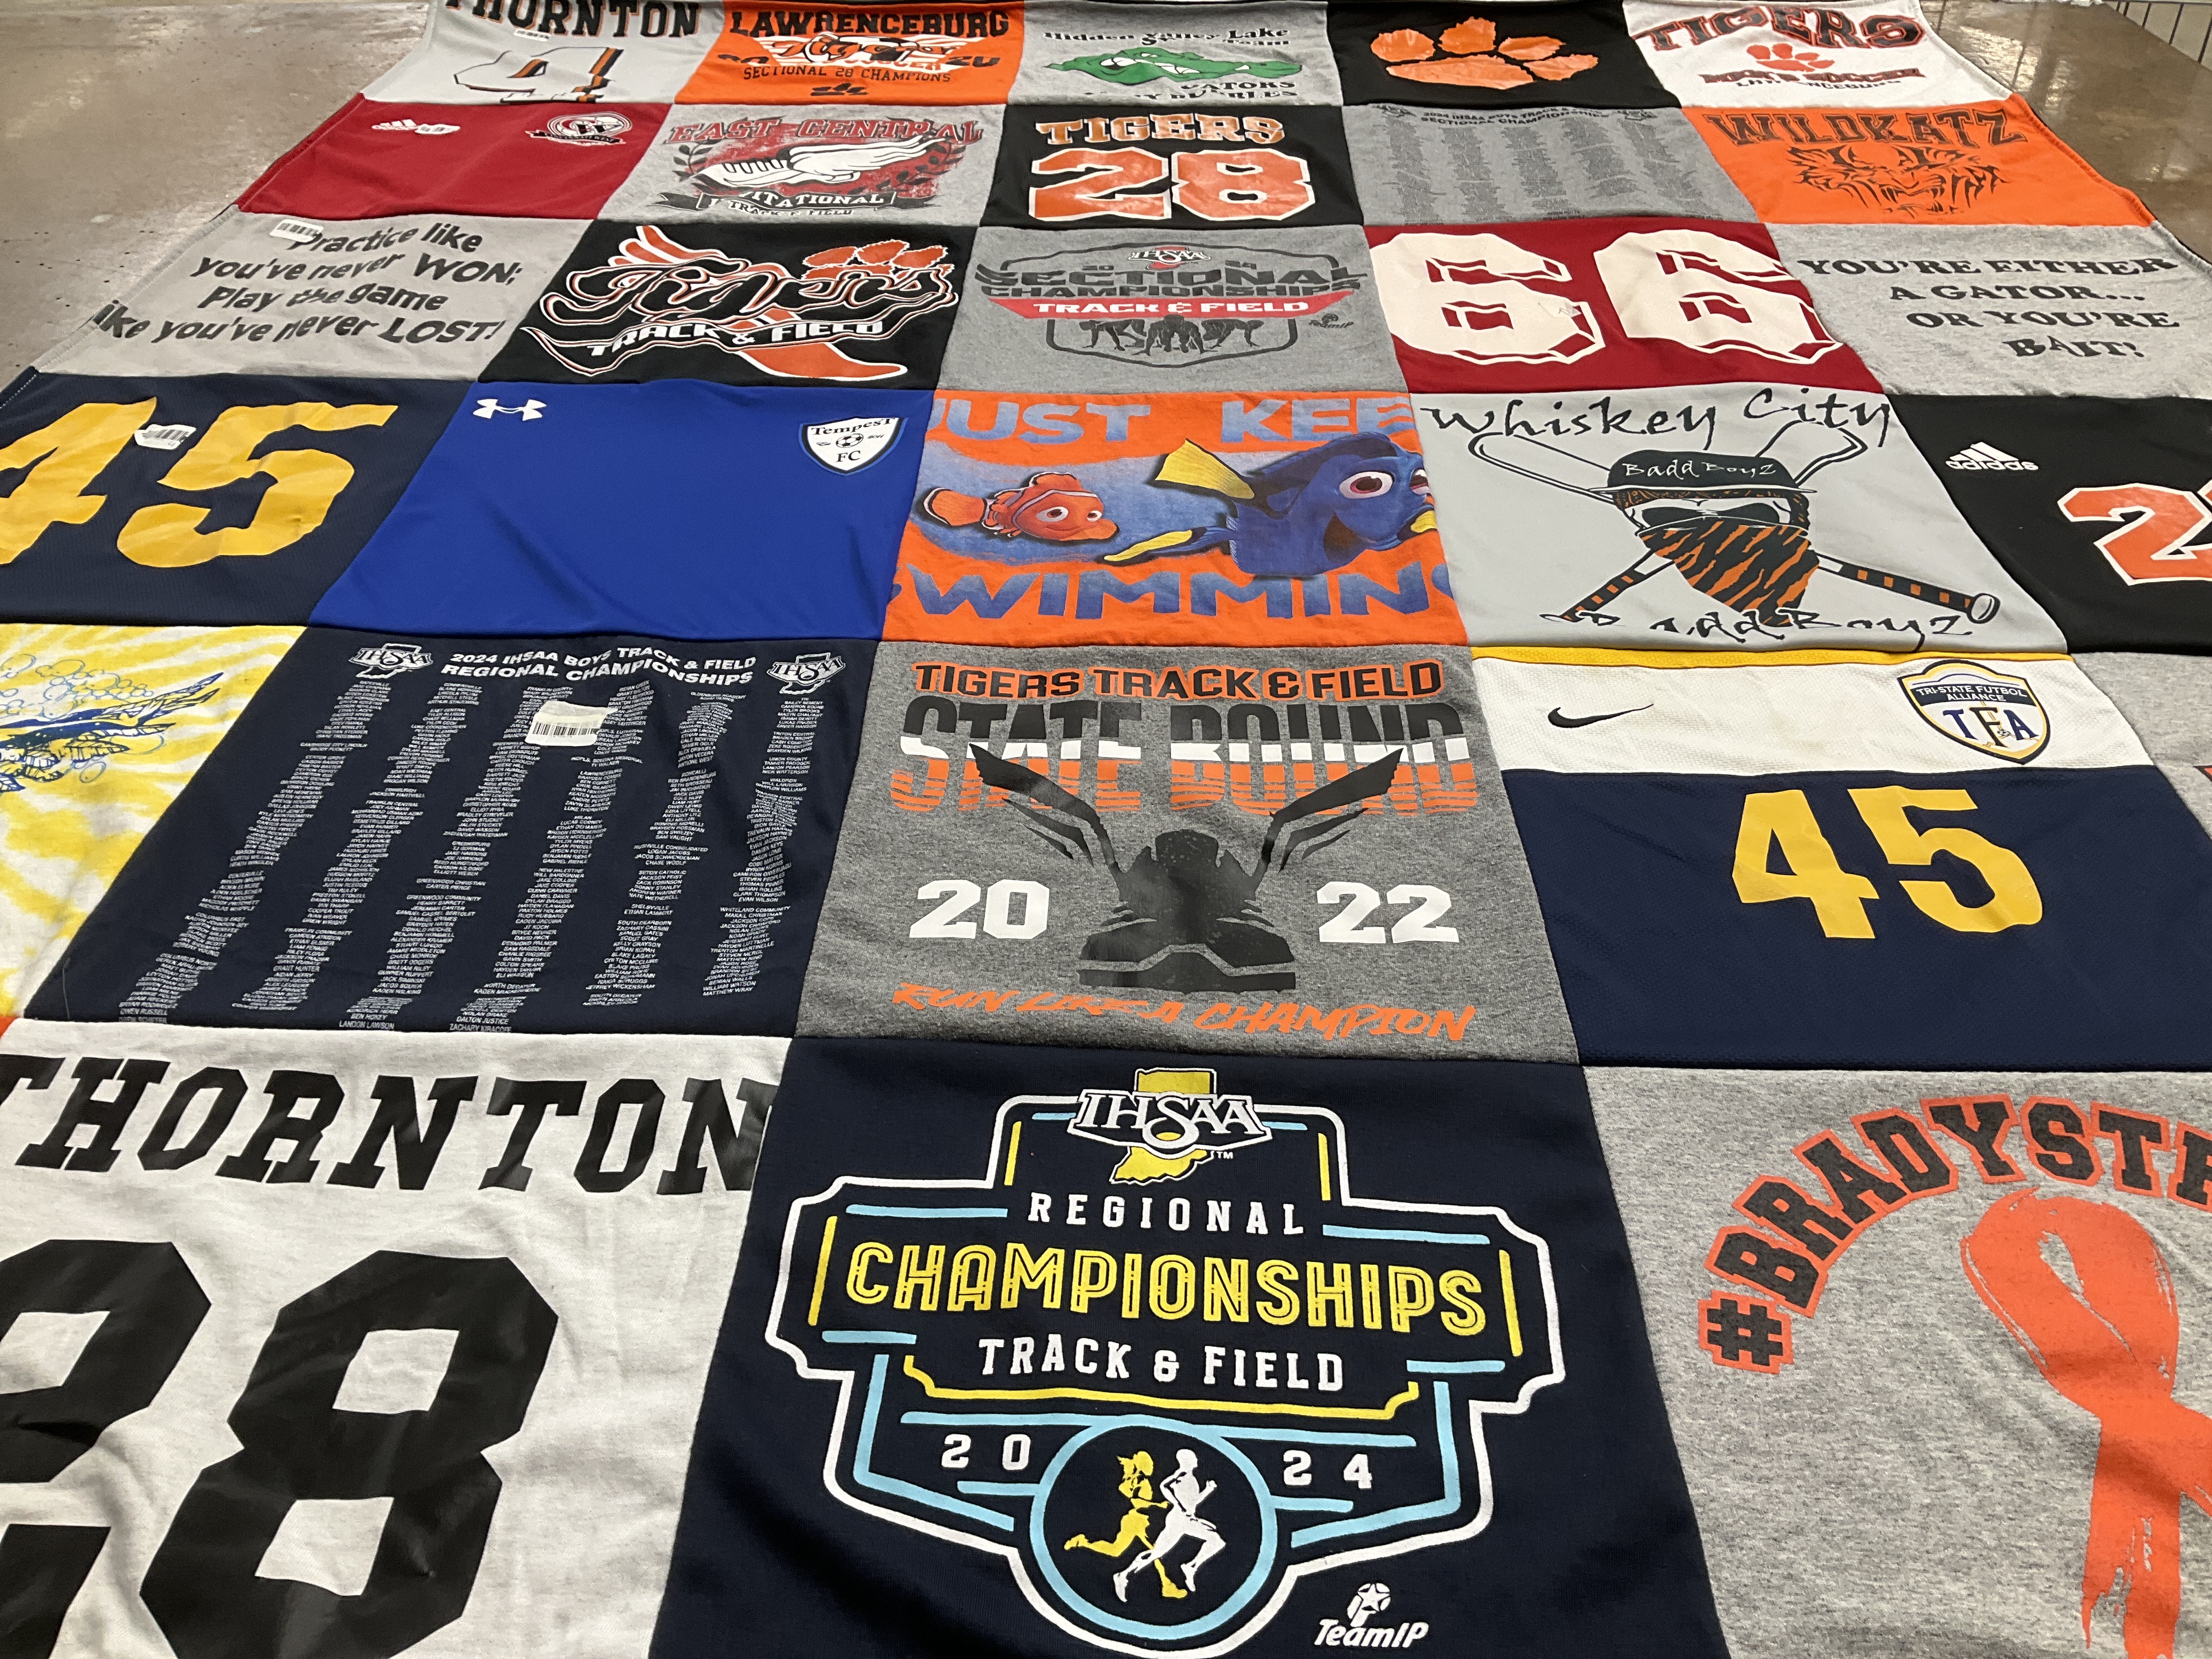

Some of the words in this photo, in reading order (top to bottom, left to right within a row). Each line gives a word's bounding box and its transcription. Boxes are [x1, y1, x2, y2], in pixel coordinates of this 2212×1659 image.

[445, 0, 700, 37] HORNTON
[730, 10, 1008, 37] LAWRENCEBURG
[1630, 5, 1926, 50] TIGERS
[1228, 27, 1289, 40] Lake
[743, 65, 827, 80] SECTIONAL
[836, 67, 854, 78] 28
[861, 68, 951, 82] CHAMPIONS
[662, 117, 786, 144] EAST
[797, 118, 985, 144] CENTRAL
[1036, 114, 1285, 145] TIGERS
[1702, 108, 2029, 147] WILDKATZ
[1029, 146, 1316, 222] 28
[287, 226, 419, 252] Practice
[421, 222, 483, 253] like
[190, 257, 307, 280] you've
[307, 253, 406, 281] never
[1129, 249, 1211, 264] IHSAA
[1797, 259, 1981, 274] YOU'RE
[1983, 258, 2180, 275] EITHER
[975, 263, 1368, 286] SECTIONAL
[981, 280, 1361, 298] CHAMPIONSHIPS
[198, 286, 284, 312] Play
[286, 287, 345, 307] the
[345, 283, 449, 311] game
[1033, 303, 1150, 314] TRACK
[1167, 301, 1193, 314] &
[1200, 302, 1310, 313] FIELD
[1369, 228, 1843, 365] 66
[1889, 286, 1927, 300] A
[1930, 285, 2146, 301] GATOR...
[79, 300, 151, 338] ike
[151, 316, 273, 343] you've
[272, 315, 380, 343] never
[377, 317, 508, 344] LOST!
[1905, 312, 1984, 328] OR
[1982, 311, 2181, 328] YOU'RE
[586, 323, 721, 357] TRACK
[771, 321, 883, 342] FIELD
[2002, 335, 2146, 358] BAIT!
[1420, 396, 1717, 450] Whiskey
[1743, 387, 1891, 447] City
[835, 450, 861, 463] FC
[1621, 459, 1700, 480] Badd
[1945, 459, 2039, 471] adidas
[0, 396, 399, 568] 45
[2057, 478, 2212, 586] 2
[890, 560, 1457, 619] WIMMIN
[441, 664, 559, 678] REGIONAL
[565, 658, 753, 686] CHAMPIONSHIPS
[450, 653, 498, 664] 2024
[501, 650, 558, 665] IHSAA
[563, 650, 612, 668] BOYS
[617, 647, 679, 668] TRACK
[683, 661, 699, 669] &
[704, 657, 757, 671] FIELD
[771, 656, 845, 684] IHSAA
[911, 662, 1085, 699] TIGERS
[1088, 665, 1259, 701] TRACK
[1262, 670, 1302, 701] &
[1307, 659, 1445, 701] FIELD
[1916, 686, 1972, 696] TRI-STATE
[1976, 686, 2028, 697] FUTBOL
[1947, 693, 2007, 702] ALLIANCE
[1942, 706, 2040, 748] TFA
[889, 695, 1142, 813] STATE
[1170, 702, 1478, 816] BOUND
[1732, 785, 2043, 939] 45
[909, 879, 1050, 940] 20
[1316, 881, 1460, 944] 22
[702, 988, 734, 996] MATTHEW
[338, 1020, 365, 1029] LANDON
[366, 1021, 396, 1030] LAWSON
[483, 1017, 510, 1025] JUSTICE
[892, 982, 1020, 1012] RUN
[1016, 990, 1148, 1015] LIKE
[1141, 1000, 1186, 1024] A
[1194, 1001, 1477, 1041] CHAMPION
[450, 1023, 479, 1032] ZACHARY
[0, 1053, 781, 1195] THORNTON
[1076, 1088, 1259, 1153] IHSAA
[1215, 1150, 1234, 1160] TM
[1028, 1192, 1305, 1235] REGIONAL
[846, 1242, 1486, 1335] CHAMPIONSHIPS
[979, 1338, 1131, 1381] TRACK
[1153, 1349, 1181, 1383] &
[1204, 1345, 1344, 1392] FIELD
[1314, 1618, 1429, 1648] TeamIP
